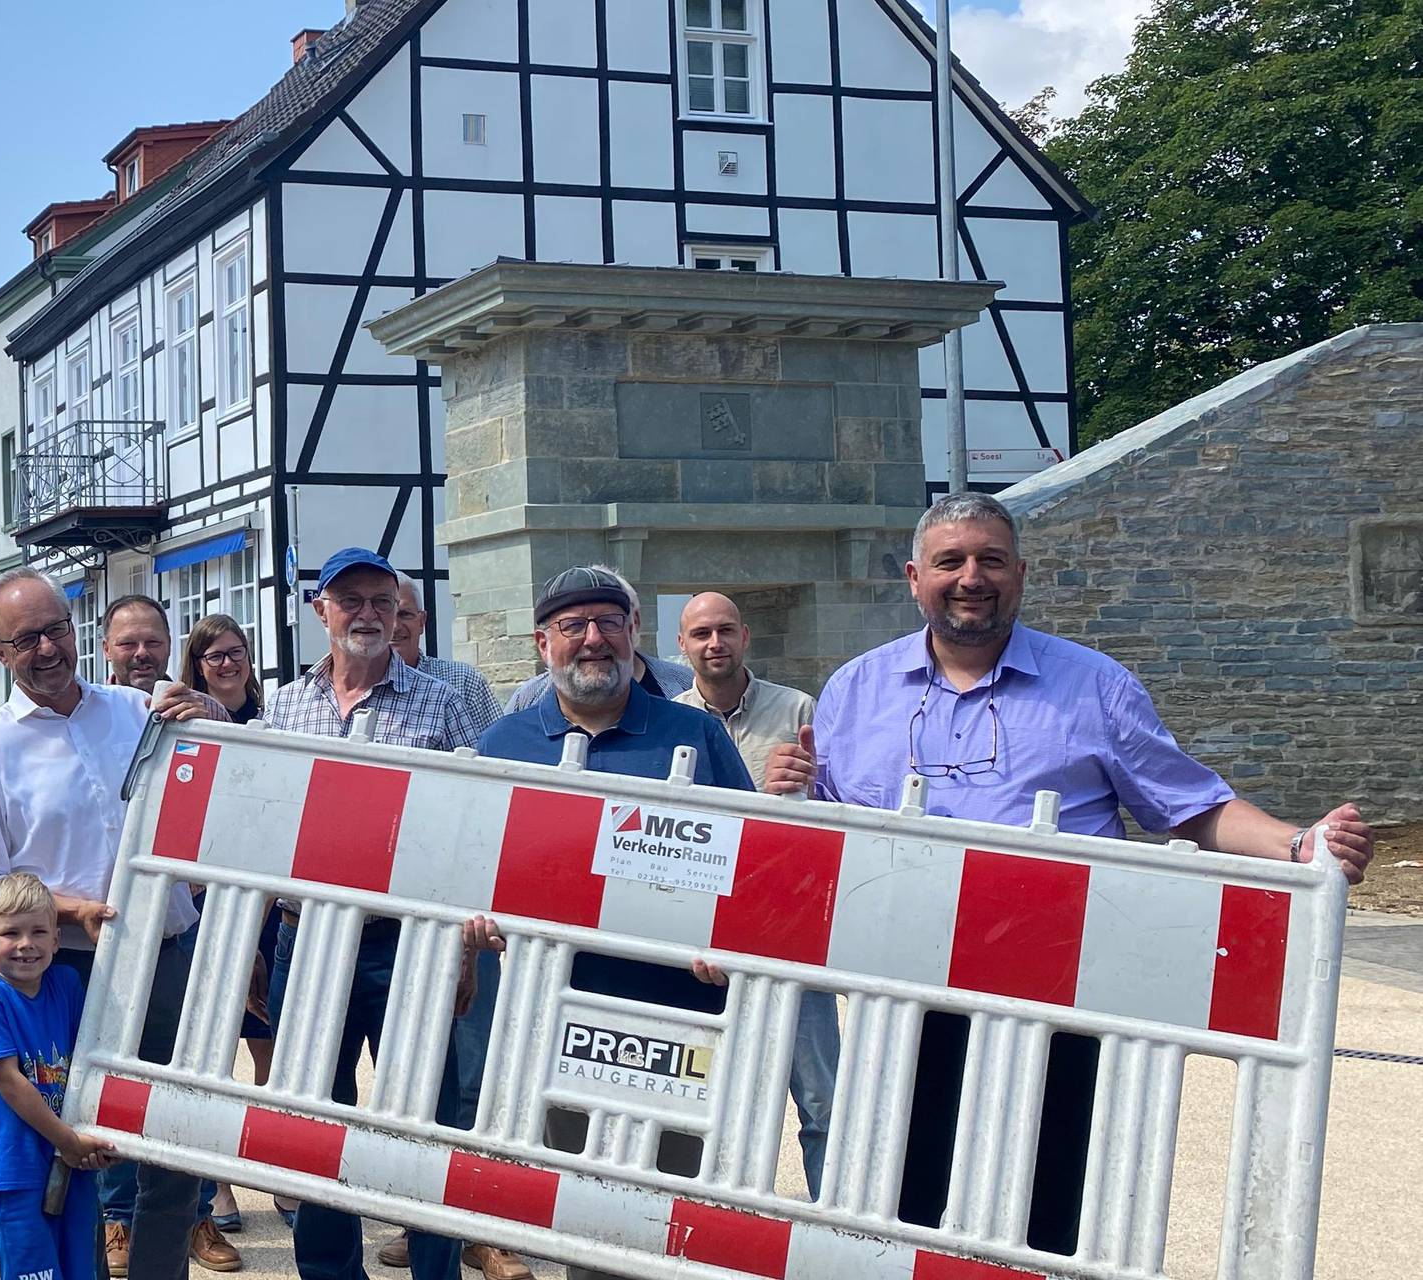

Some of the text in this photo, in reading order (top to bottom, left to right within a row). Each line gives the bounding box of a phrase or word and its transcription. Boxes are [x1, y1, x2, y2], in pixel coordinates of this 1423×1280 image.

[644, 814, 713, 844] MCS
[613, 836, 728, 867] VerkehrsRaum
[610, 856, 726, 881] Plan Bau Service
[565, 1025, 706, 1079] PROFIL
[558, 1061, 708, 1101] BAUGERÄTE
